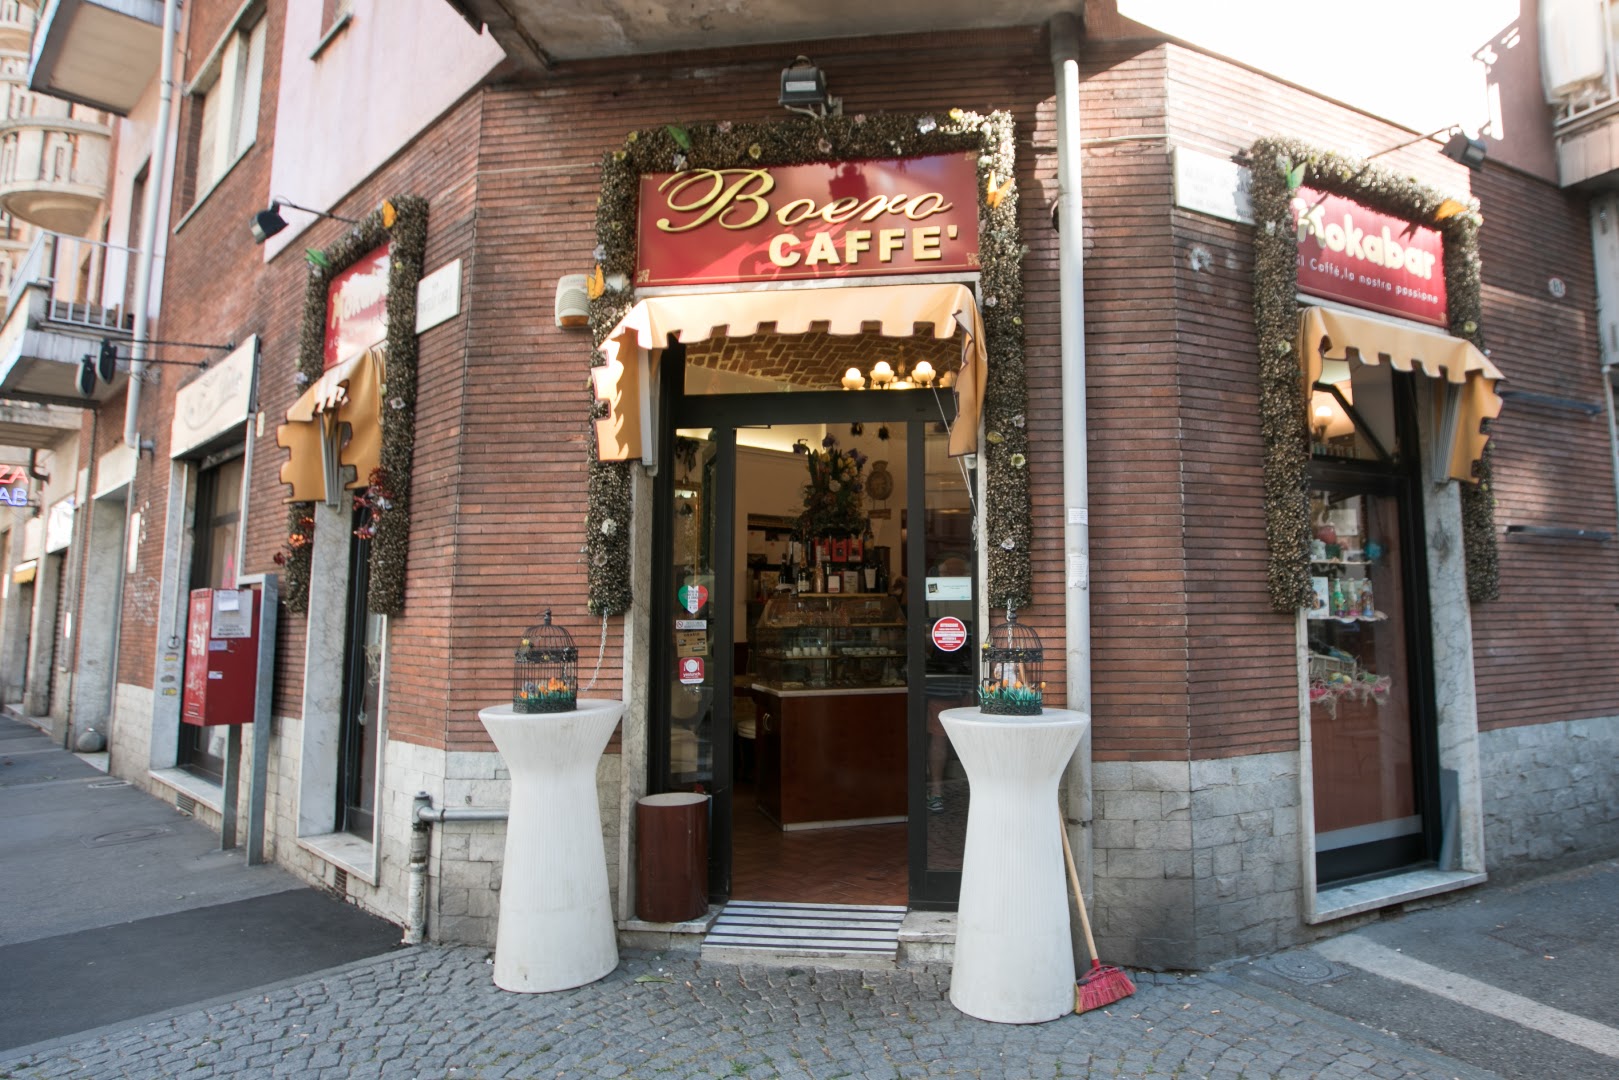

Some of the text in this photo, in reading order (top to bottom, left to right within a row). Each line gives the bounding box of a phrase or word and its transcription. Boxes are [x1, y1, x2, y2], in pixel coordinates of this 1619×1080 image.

[655, 167, 953, 233] Boero
[768, 225, 958, 267] CAFFE'
[1292, 197, 1436, 280] Kokabar
[1358, 274, 1392, 291] nostra
[1395, 283, 1439, 305] passione
